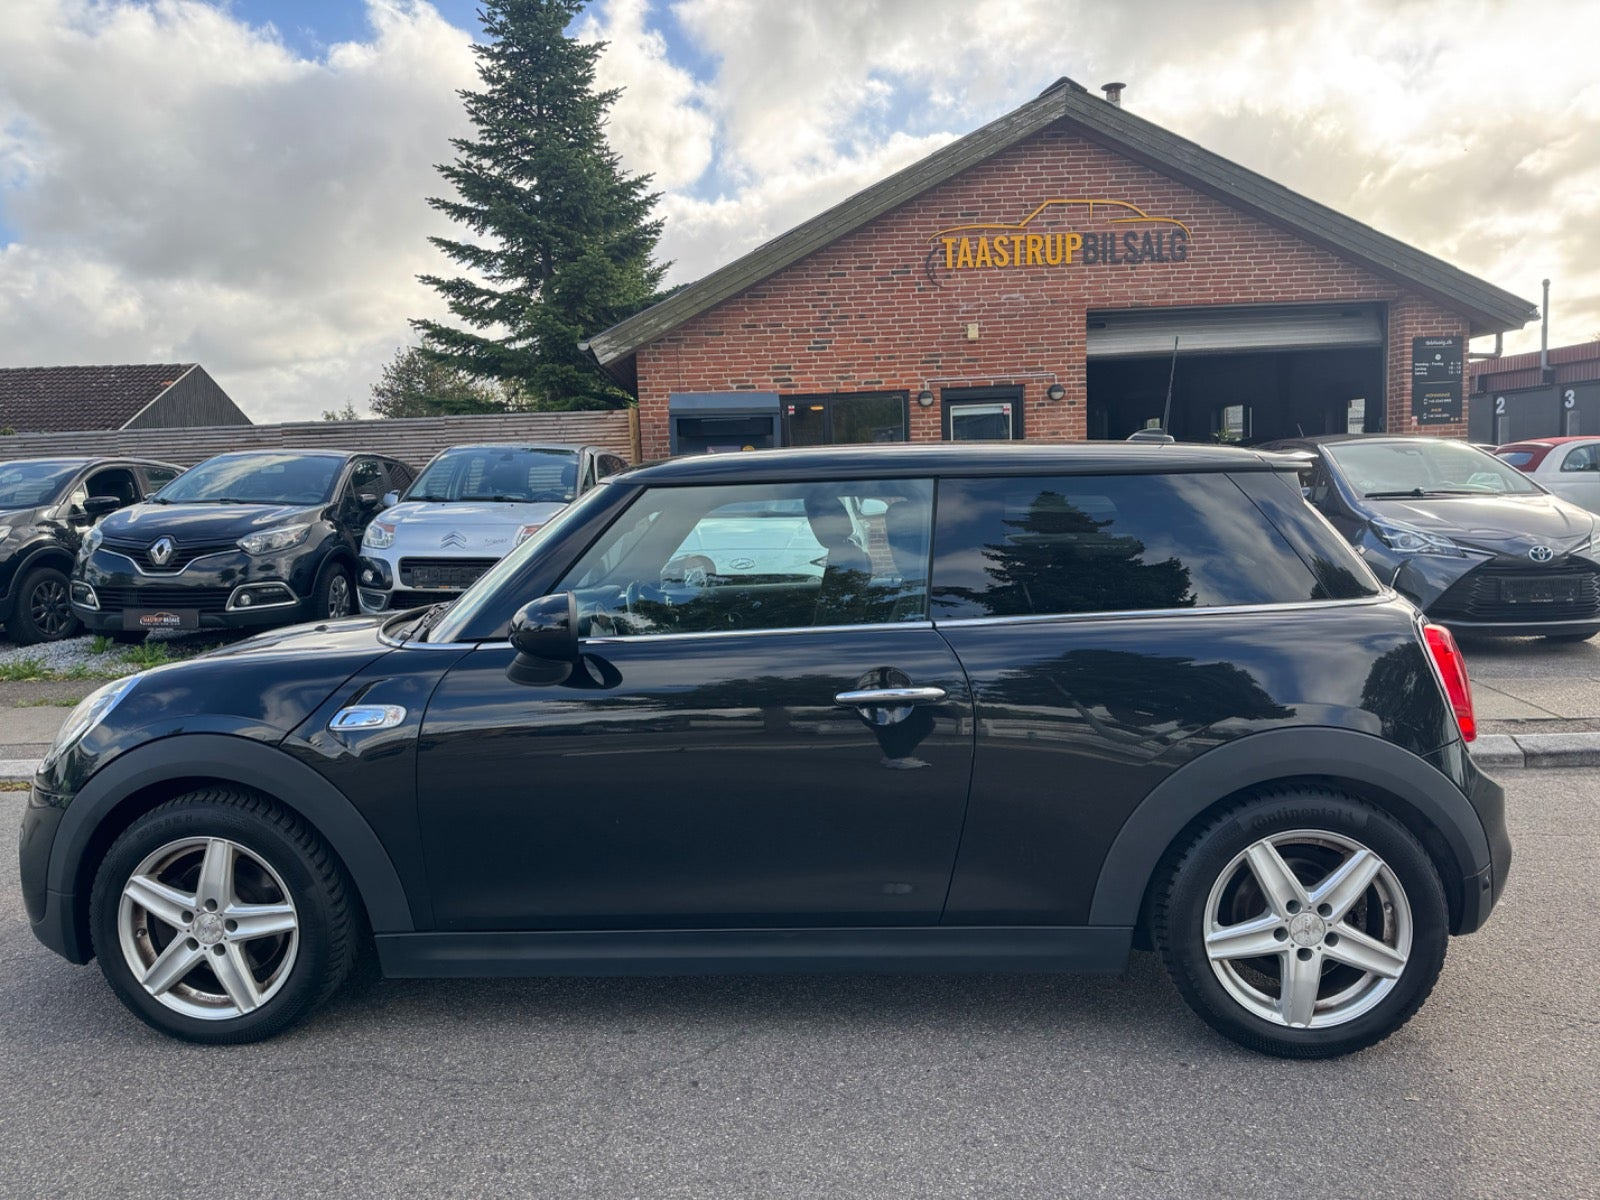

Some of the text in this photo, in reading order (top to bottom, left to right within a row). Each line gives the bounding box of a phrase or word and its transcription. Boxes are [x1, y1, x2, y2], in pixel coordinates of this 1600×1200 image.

[941, 229, 1188, 269] TAASTRUPBILSALG
[1496, 396, 1506, 414] 2
[1564, 389, 1575, 409] 3
